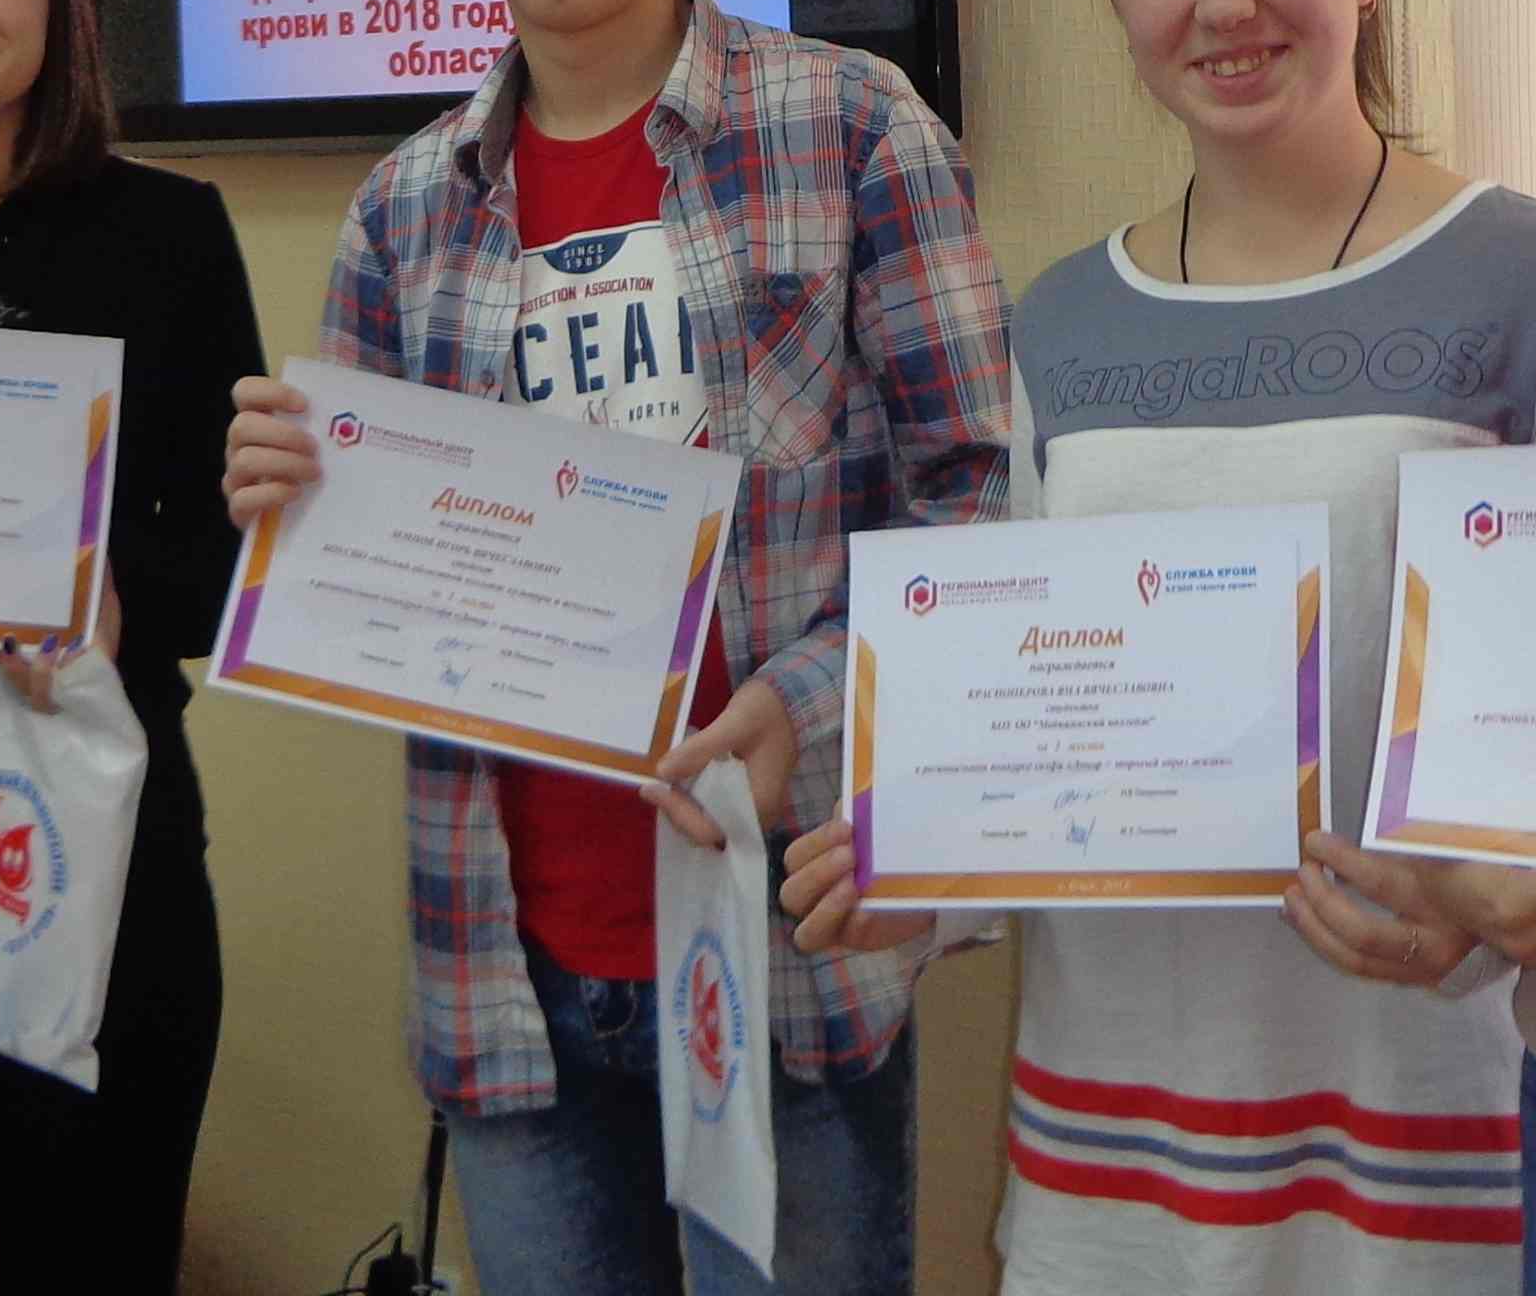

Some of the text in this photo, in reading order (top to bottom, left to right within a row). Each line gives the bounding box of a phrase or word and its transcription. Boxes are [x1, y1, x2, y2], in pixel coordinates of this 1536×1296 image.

[242, 10, 328, 48] крови
[339, 11, 355, 35] в
[389, 40, 505, 77] област
[564, 244, 606, 258] SINCE
[519, 277, 655, 314] ROTECTION ASSOCIATION
[628, 401, 680, 422] NORTH
[431, 487, 536, 527] Диплом
[941, 576, 1017, 592] РЕГИОНАЛЬНЫЙ
[1166, 565, 1257, 580] СЛУЖБА КРОВИ
[1018, 625, 1125, 656] Диплом
